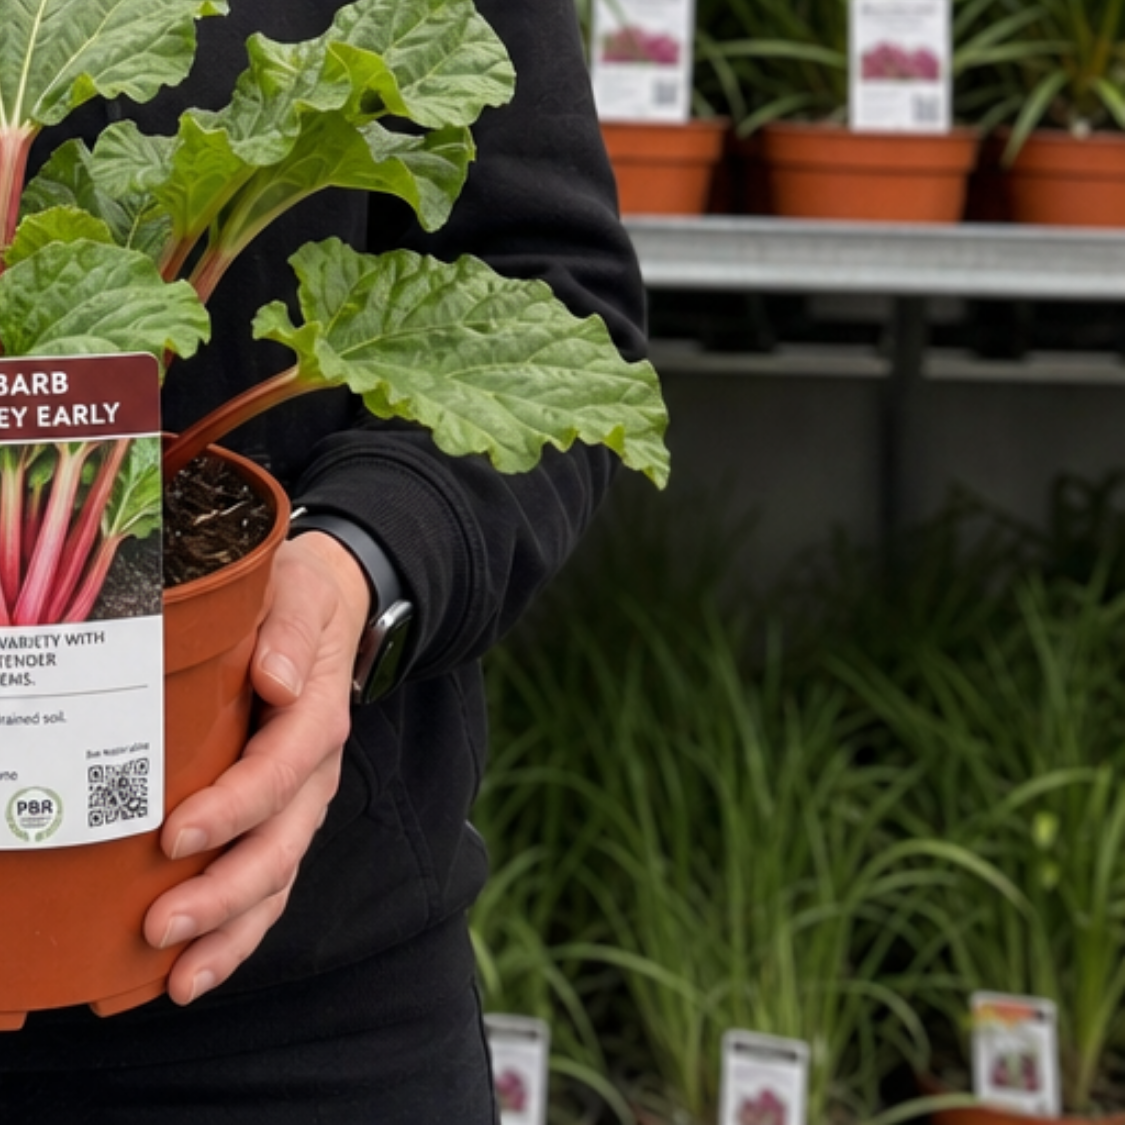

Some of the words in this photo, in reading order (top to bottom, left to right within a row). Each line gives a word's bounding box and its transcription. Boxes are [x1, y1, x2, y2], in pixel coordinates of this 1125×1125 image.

[36, 402, 120, 427] EARLY
[64, 631, 106, 647] WITH
[17, 799, 54, 816] PBR
